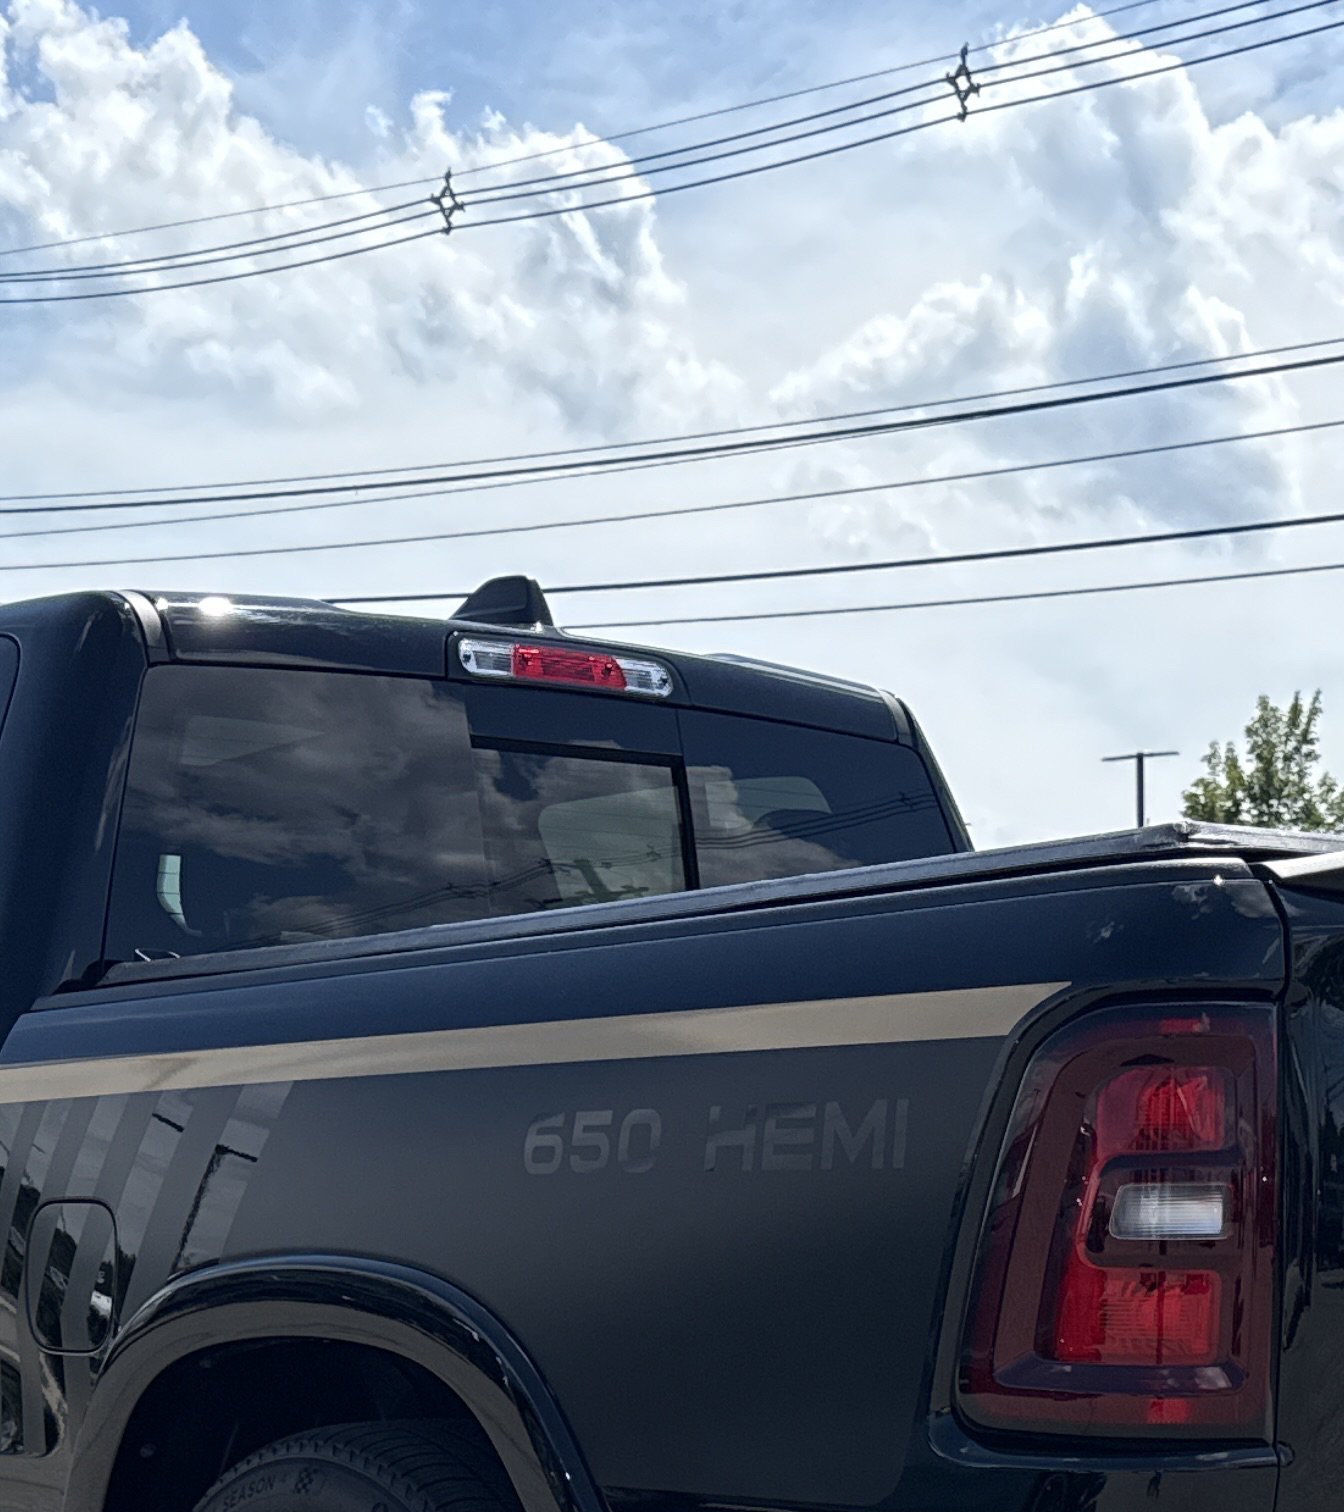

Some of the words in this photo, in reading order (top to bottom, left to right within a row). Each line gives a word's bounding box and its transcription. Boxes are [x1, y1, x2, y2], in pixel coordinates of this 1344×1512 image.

[524, 1108, 662, 1175] 650
[704, 1098, 910, 1173] HEMI
[222, 1475, 276, 1512] SEASON
